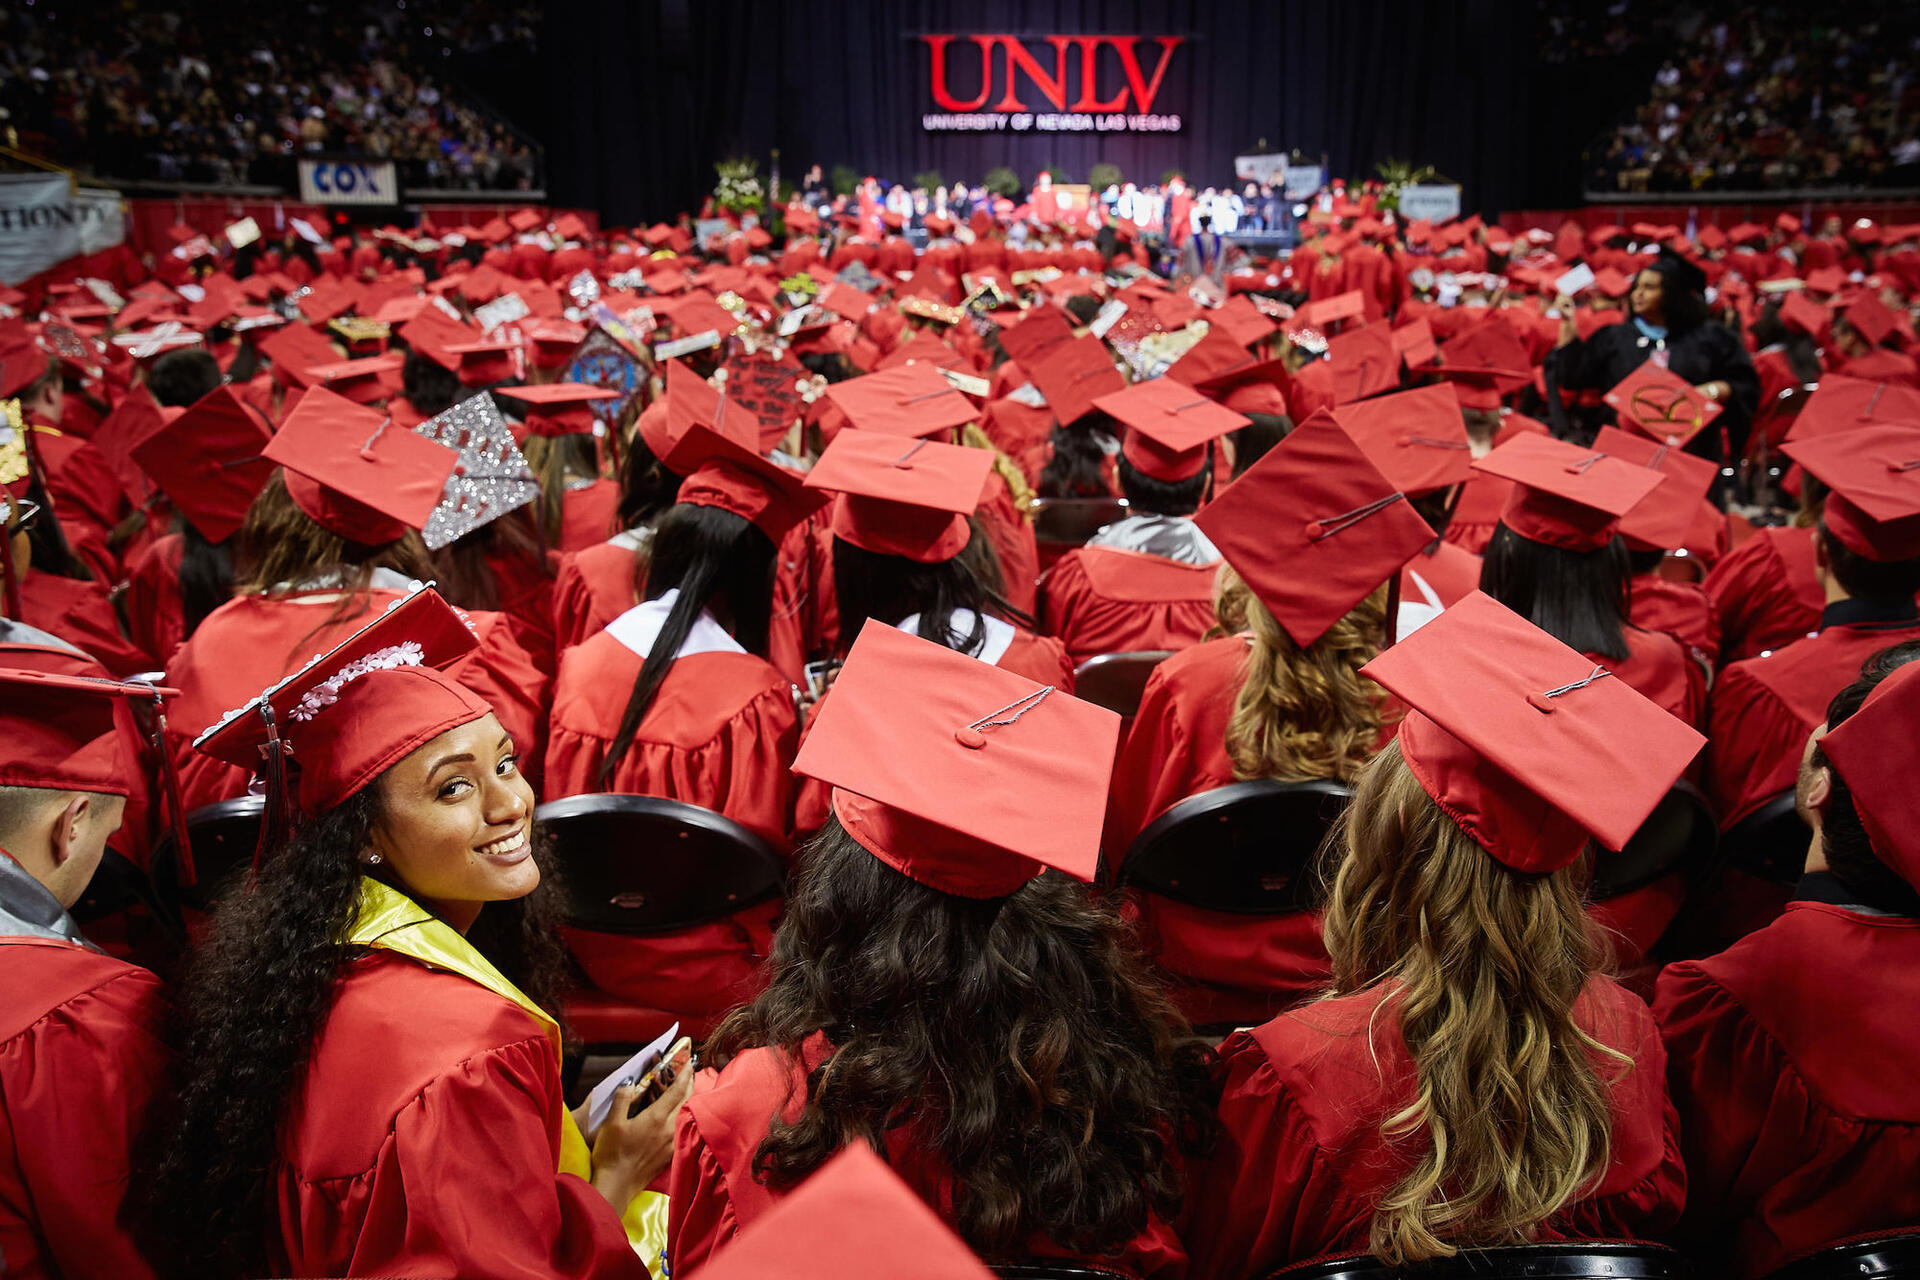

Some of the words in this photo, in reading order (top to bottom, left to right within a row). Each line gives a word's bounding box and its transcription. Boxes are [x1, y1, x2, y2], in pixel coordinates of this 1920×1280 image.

[920, 34, 1185, 115] UNLV
[922, 113, 1008, 131] UNIVERSITY
[1010, 113, 1034, 131] OF
[1036, 113, 1094, 131] NEVADA
[1095, 113, 1127, 132] LAS
[1127, 114, 1181, 132] VEGAS
[312, 161, 380, 195] COX
